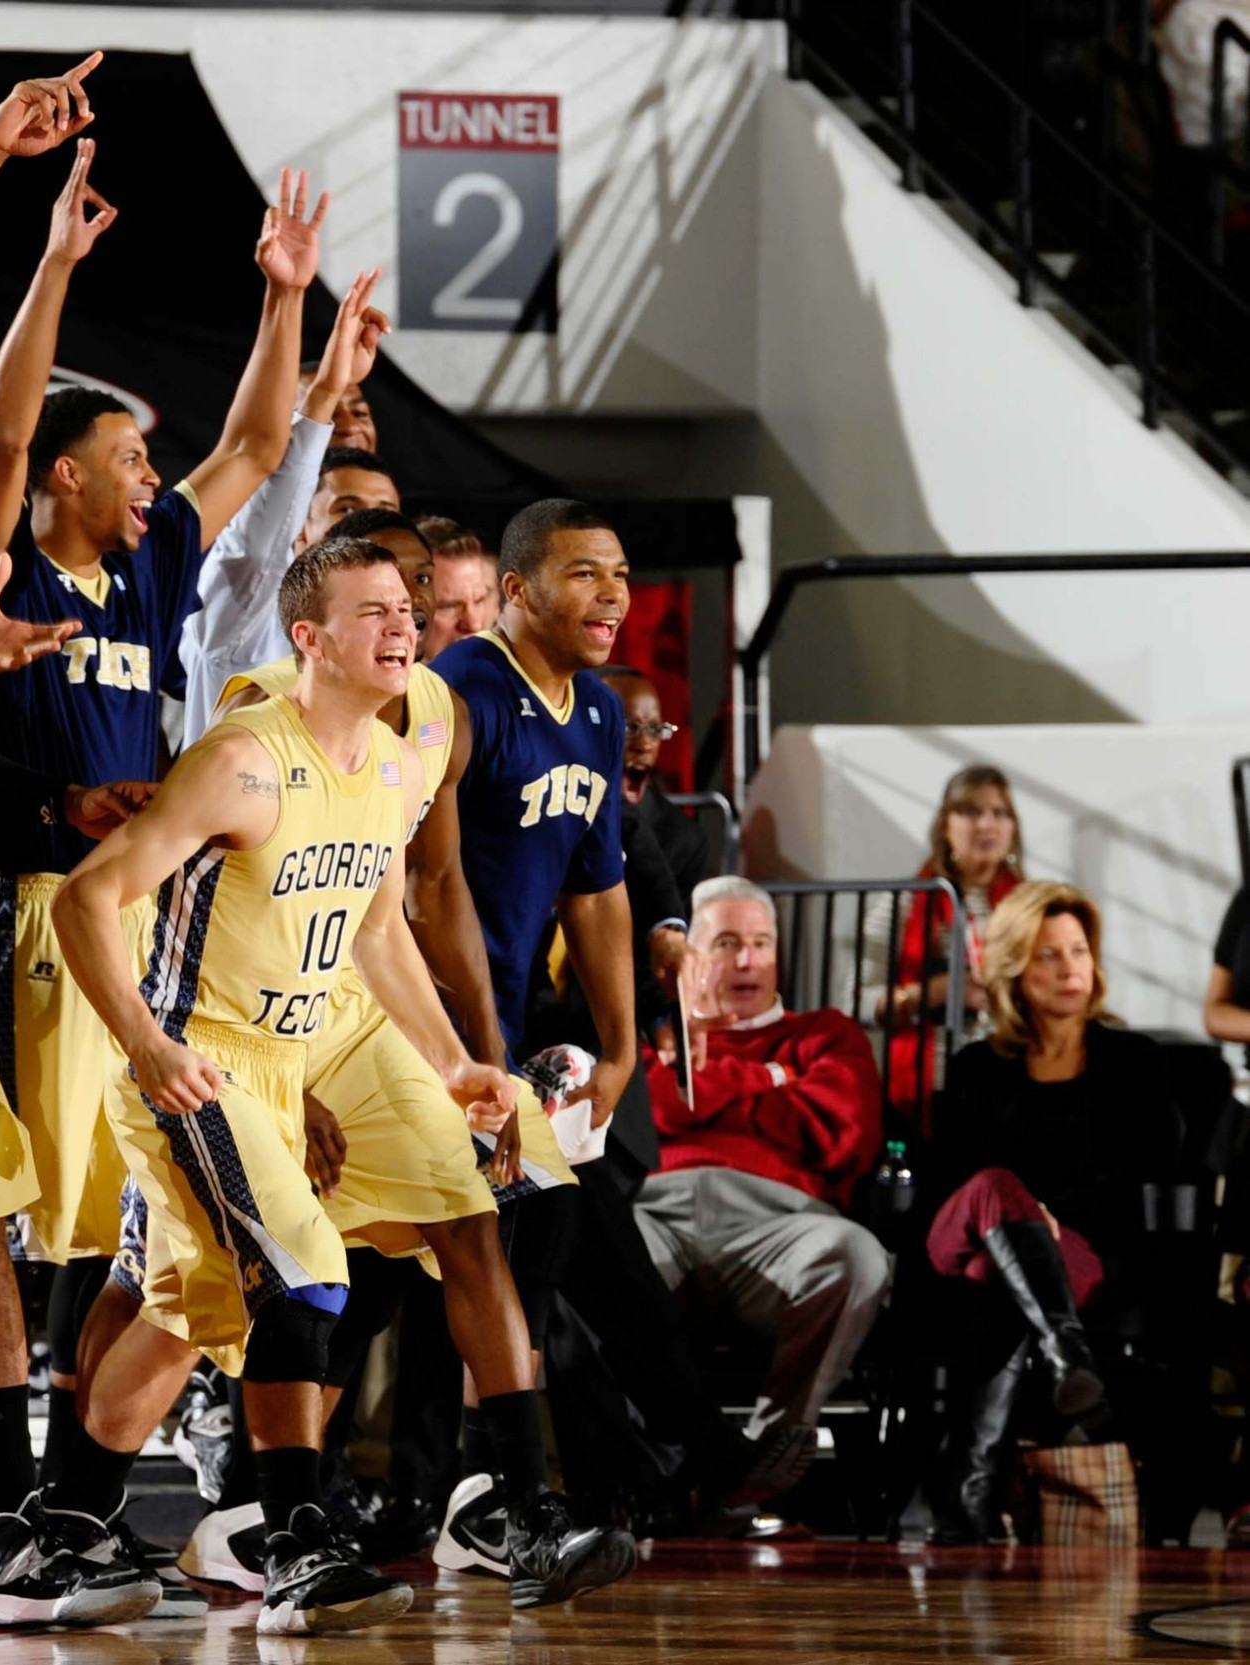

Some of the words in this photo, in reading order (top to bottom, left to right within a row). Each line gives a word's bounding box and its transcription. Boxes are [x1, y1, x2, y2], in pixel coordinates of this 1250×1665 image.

[401, 100, 558, 144] TUNNEL
[431, 171, 524, 318] 2
[270, 841, 393, 898] GEORGIA
[300, 908, 348, 974] 10
[250, 988, 328, 1036] TEC
